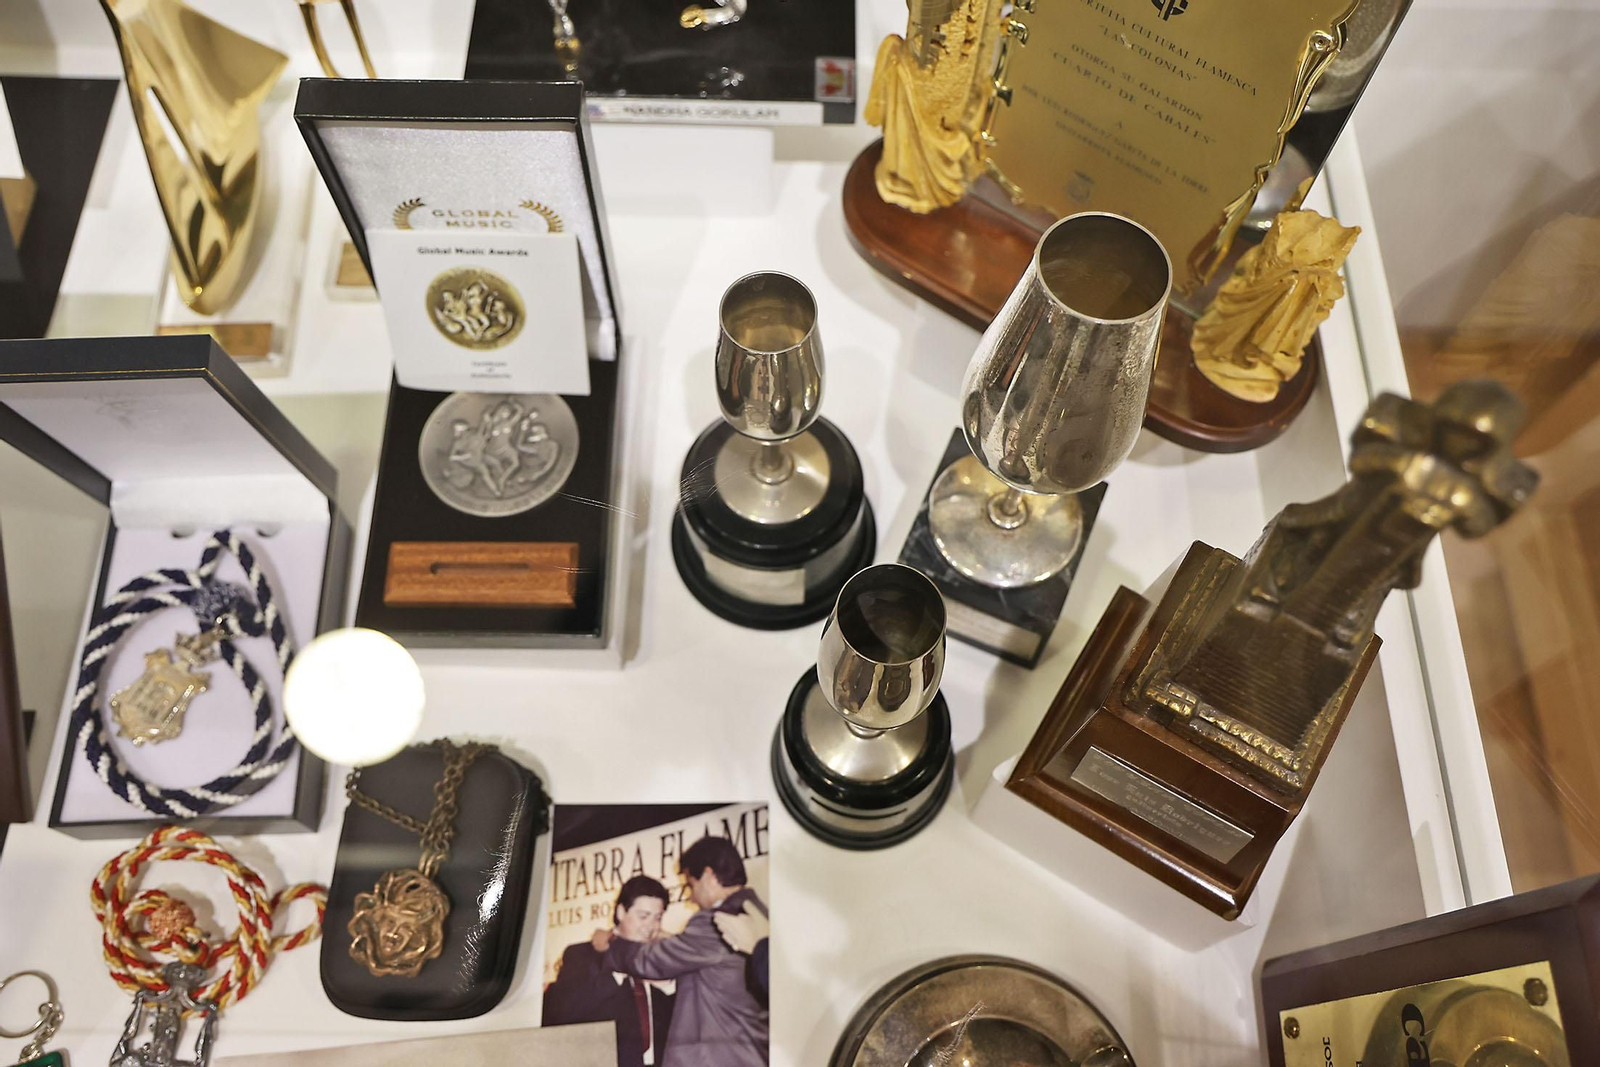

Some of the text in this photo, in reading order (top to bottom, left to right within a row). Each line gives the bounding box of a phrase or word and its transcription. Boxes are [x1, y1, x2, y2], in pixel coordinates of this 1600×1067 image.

[1071, 43, 1116, 75] OTORGA
[1080, 0, 1258, 97] RTULIA CULTURAL FLAMENCA
[431, 209, 520, 219] GLOBAL
[446, 219, 513, 229] MUSIC
[418, 246, 529, 257] Global Music Awards
[551, 842, 646, 902] ITARRA
[548, 905, 583, 928] LUIS
